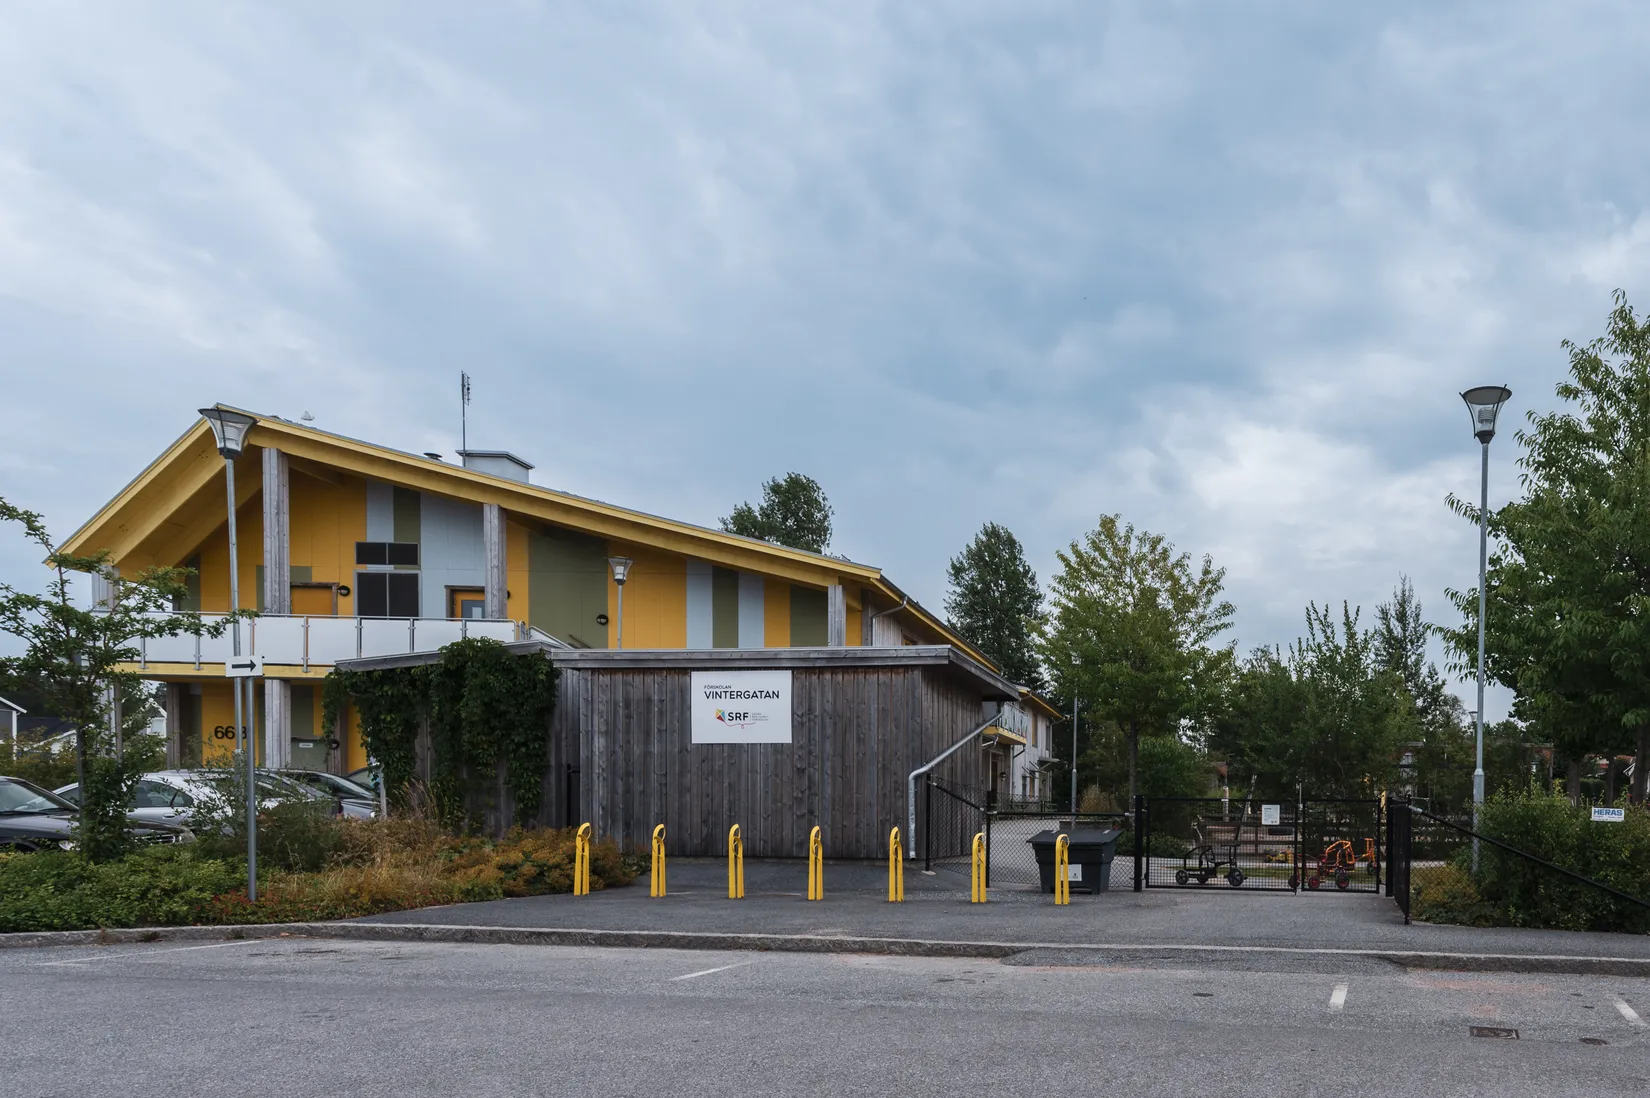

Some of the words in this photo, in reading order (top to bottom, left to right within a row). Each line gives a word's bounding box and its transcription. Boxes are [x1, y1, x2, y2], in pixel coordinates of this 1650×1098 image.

[704, 690, 780, 700] VINTERGATAN
[727, 712, 749, 721] SRF
[1593, 808, 1623, 816] HERAS
